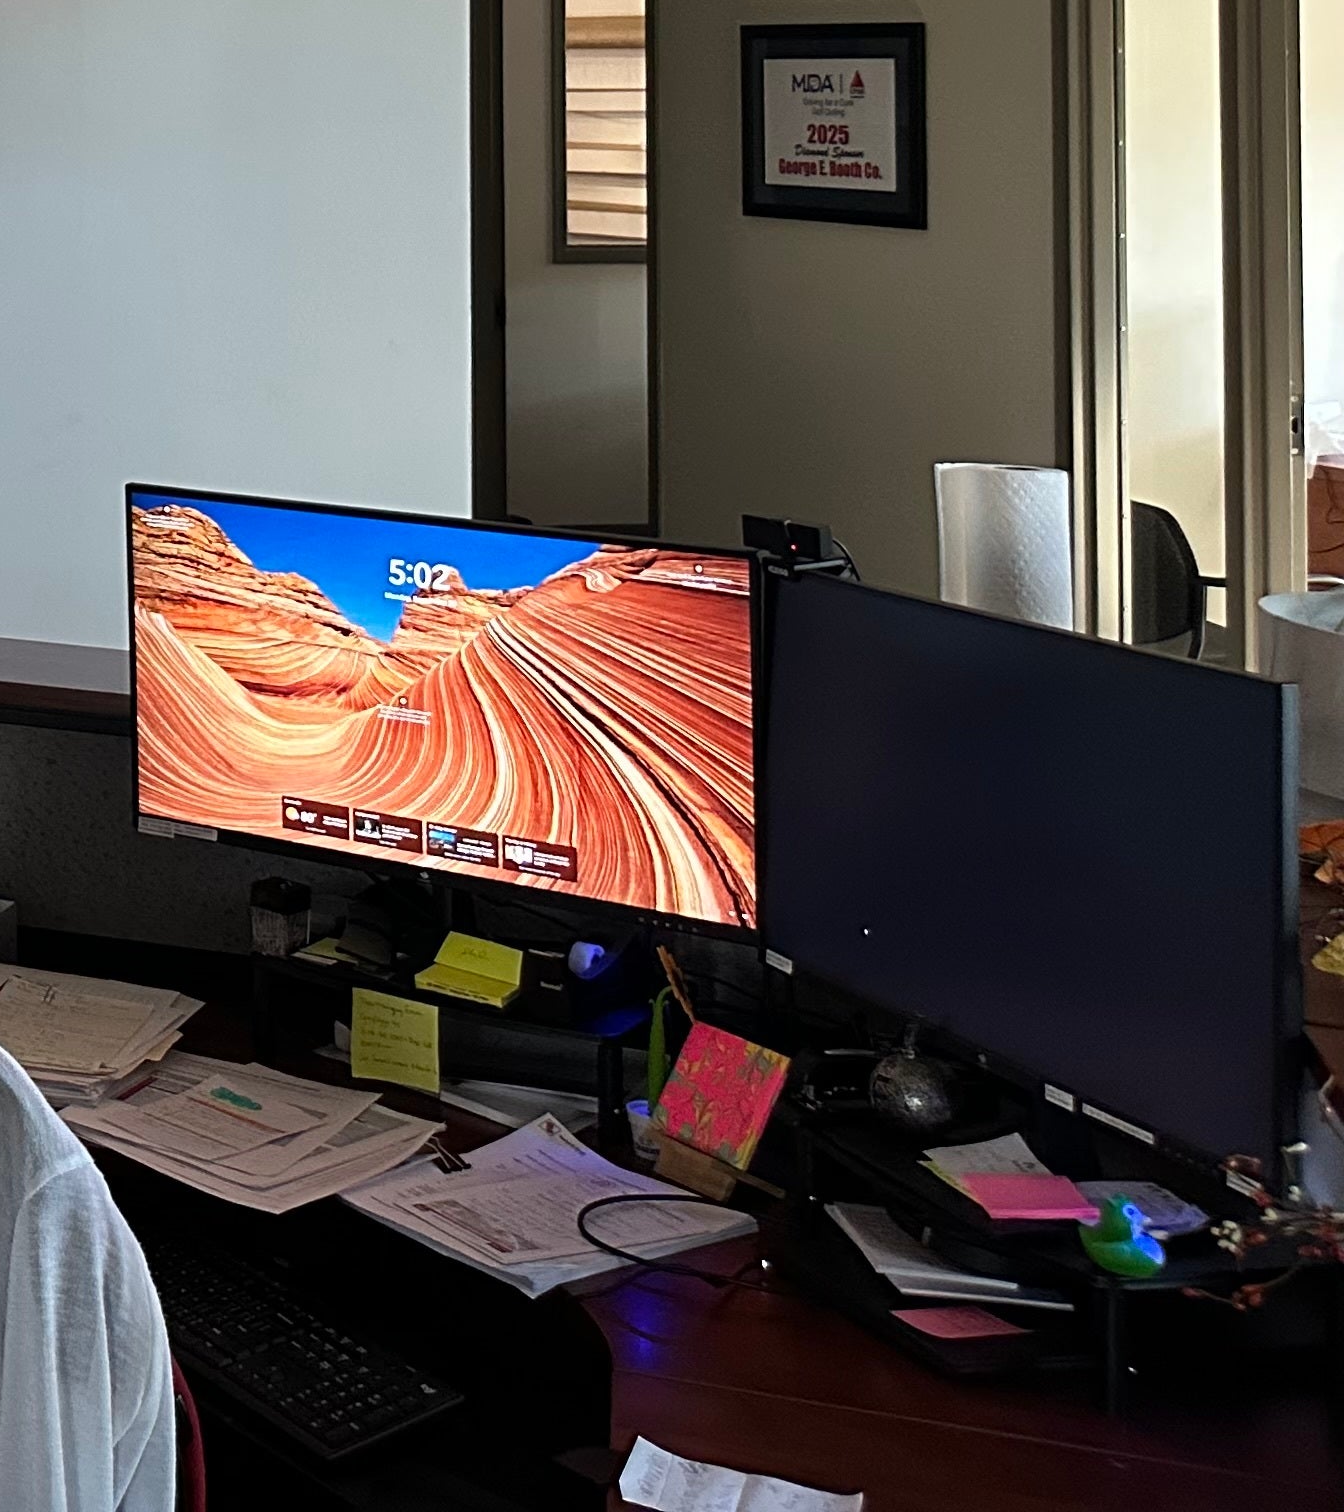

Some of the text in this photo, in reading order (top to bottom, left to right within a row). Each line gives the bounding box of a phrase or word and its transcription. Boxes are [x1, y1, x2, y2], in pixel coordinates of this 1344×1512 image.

[791, 74, 834, 93] MDA
[807, 123, 850, 145] 2025
[779, 158, 817, 176] George
[830, 160, 862, 178] Booth
[864, 162, 882, 180] Co.
[388, 558, 451, 591] 5:02
